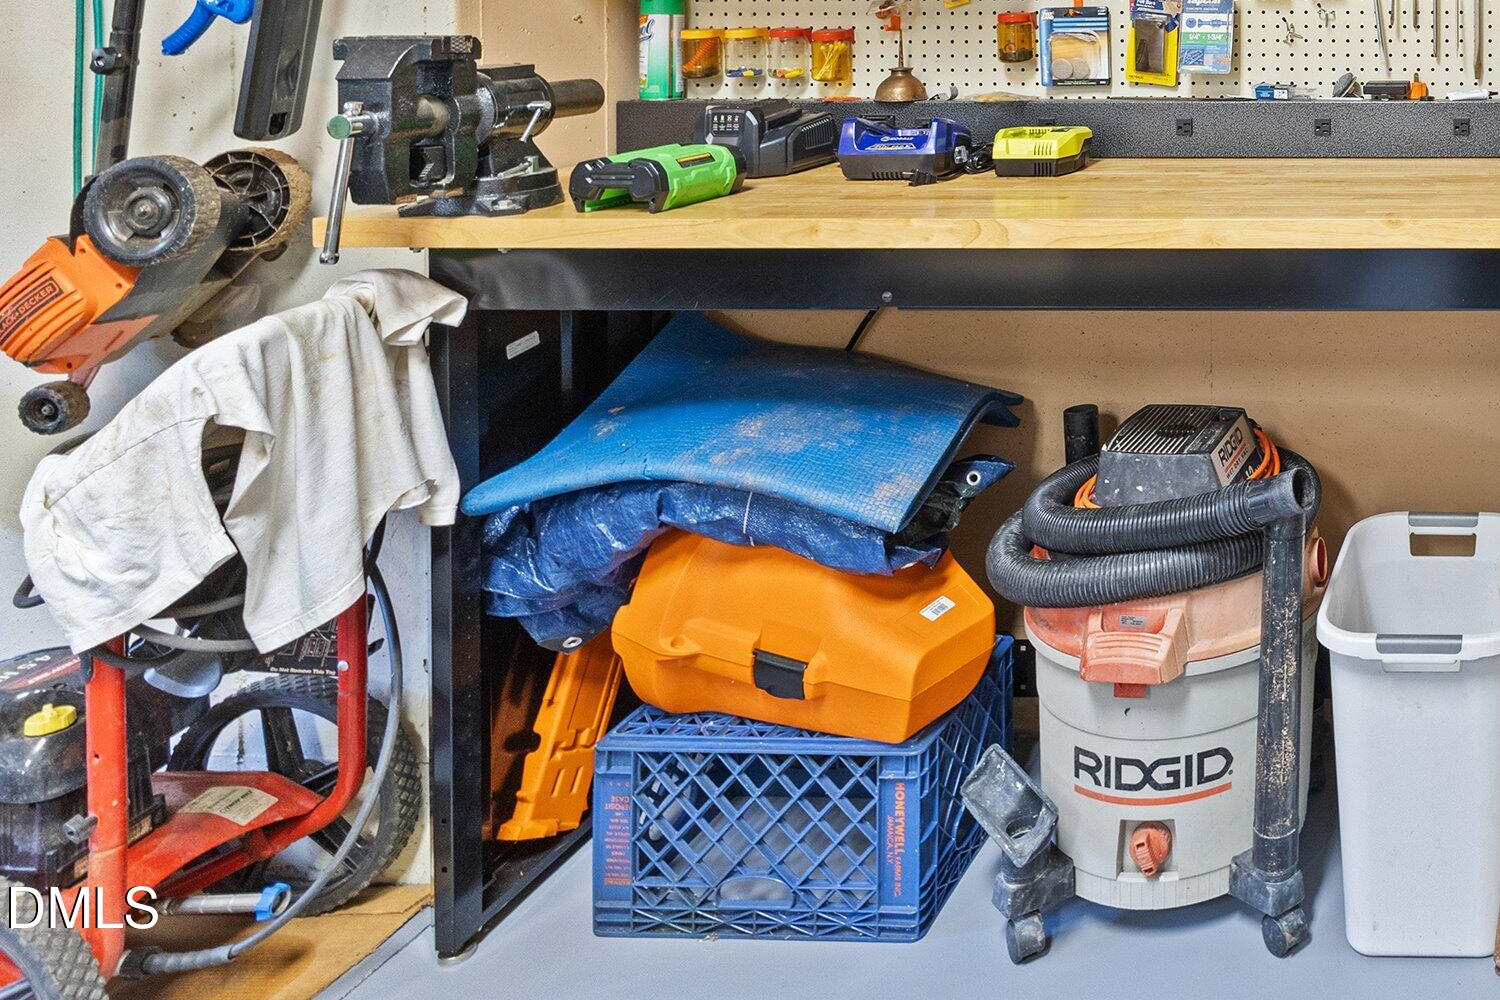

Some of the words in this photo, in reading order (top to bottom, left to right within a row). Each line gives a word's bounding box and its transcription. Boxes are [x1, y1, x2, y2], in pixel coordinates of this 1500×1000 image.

[1218, 426, 1243, 468] RIDGID
[1074, 745, 1234, 791] RIDGID
[894, 781, 906, 856] HONEYWELL
